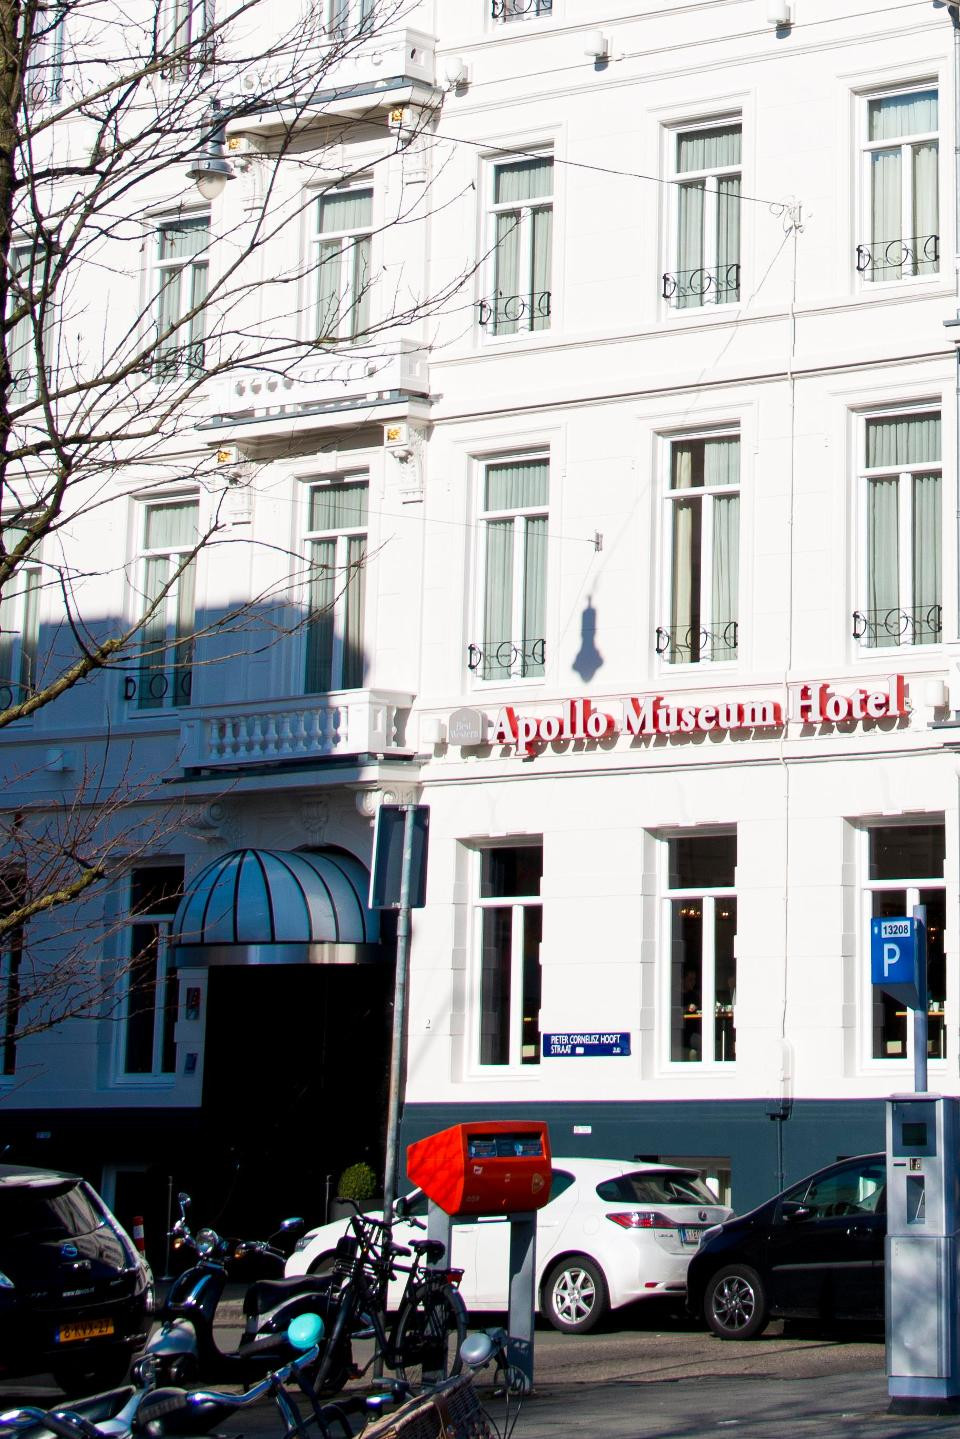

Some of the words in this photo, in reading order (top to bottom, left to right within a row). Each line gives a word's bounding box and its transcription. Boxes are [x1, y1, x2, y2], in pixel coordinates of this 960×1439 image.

[488, 698, 611, 756] Apollo
[619, 696, 782, 734] Museum
[788, 674, 905, 724] Hotel
[884, 925, 908, 935] 13208
[884, 943, 900, 977] P
[551, 1035, 569, 1044] PIETER
[570, 1035, 600, 1044] CORNELISZ
[601, 1035, 620, 1043] HOOFT
[551, 1045, 572, 1054] STRAAT
